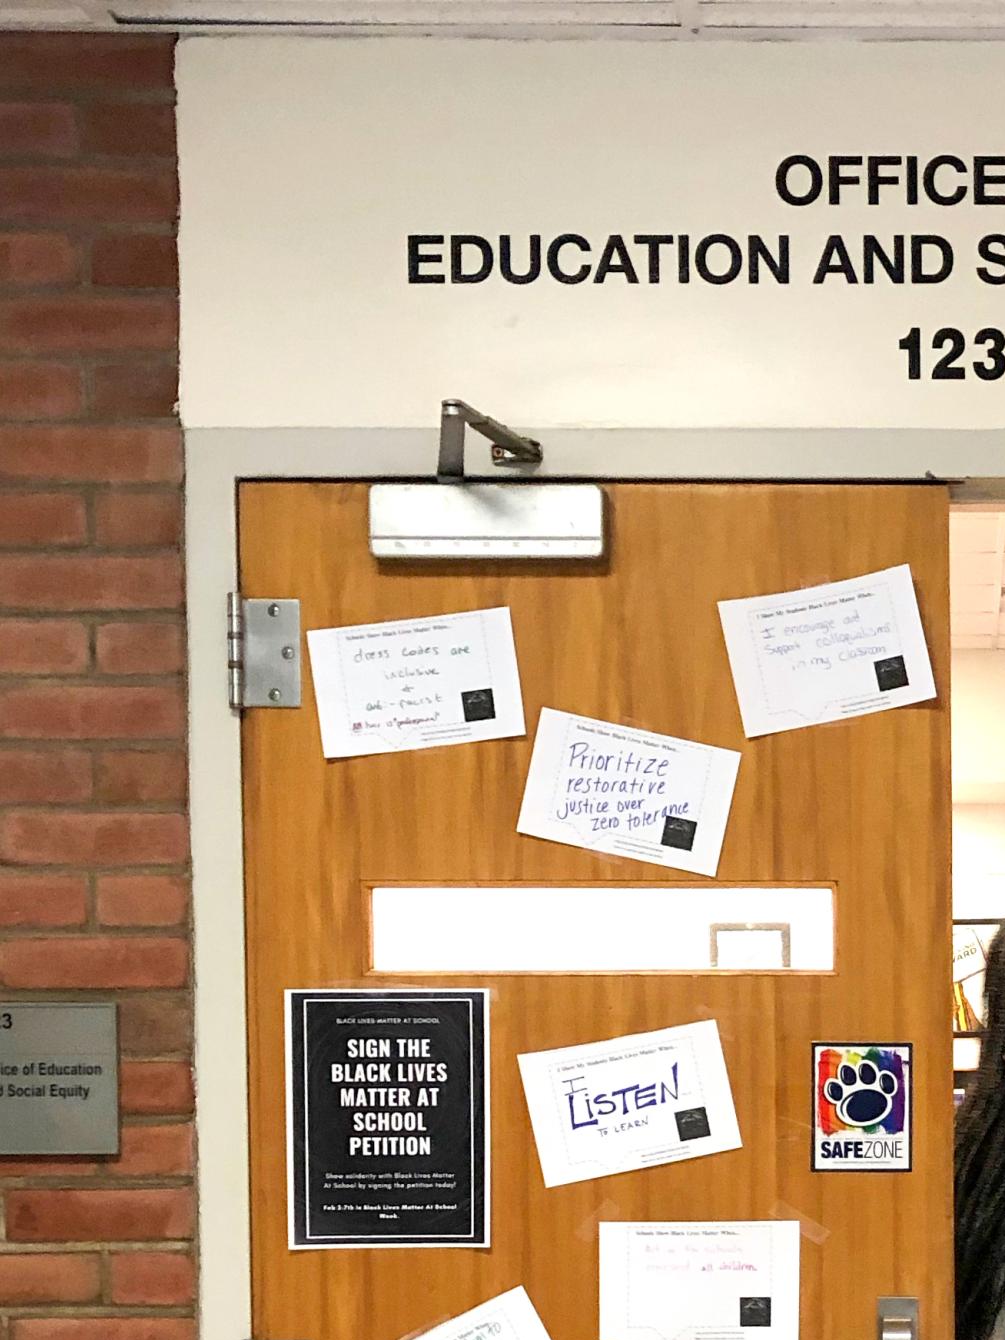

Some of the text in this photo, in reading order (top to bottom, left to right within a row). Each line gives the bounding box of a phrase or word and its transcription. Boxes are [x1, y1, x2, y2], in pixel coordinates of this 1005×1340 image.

[407, 232, 792, 287] EDUCATION
[813, 232, 955, 286] AND
[761, 627, 775, 638] I
[354, 646, 471, 663] dress codes are
[384, 668, 440, 681] inclusive
[569, 742, 669, 777] Prioritize
[567, 776, 666, 794] restorative
[557, 798, 645, 819] justice over
[591, 801, 689, 832] zero tolerance
[0, 1013, 13, 1029] 3
[347, 1038, 431, 1058] SIGN THE
[23, 1062, 34, 1076] of
[38, 1062, 102, 1076] Education
[331, 1063, 447, 1083] BLACK LIVES
[7, 1084, 90, 1100] Social Equity
[562, 1076, 587, 1096] I
[340, 1087, 440, 1107] MATTER AT
[353, 1112, 427, 1132] SCHOOL
[615, 1115, 649, 1134] LEARN
[349, 1136, 431, 1156] PETITION
[821, 1141, 903, 1158] SAFEZONE
